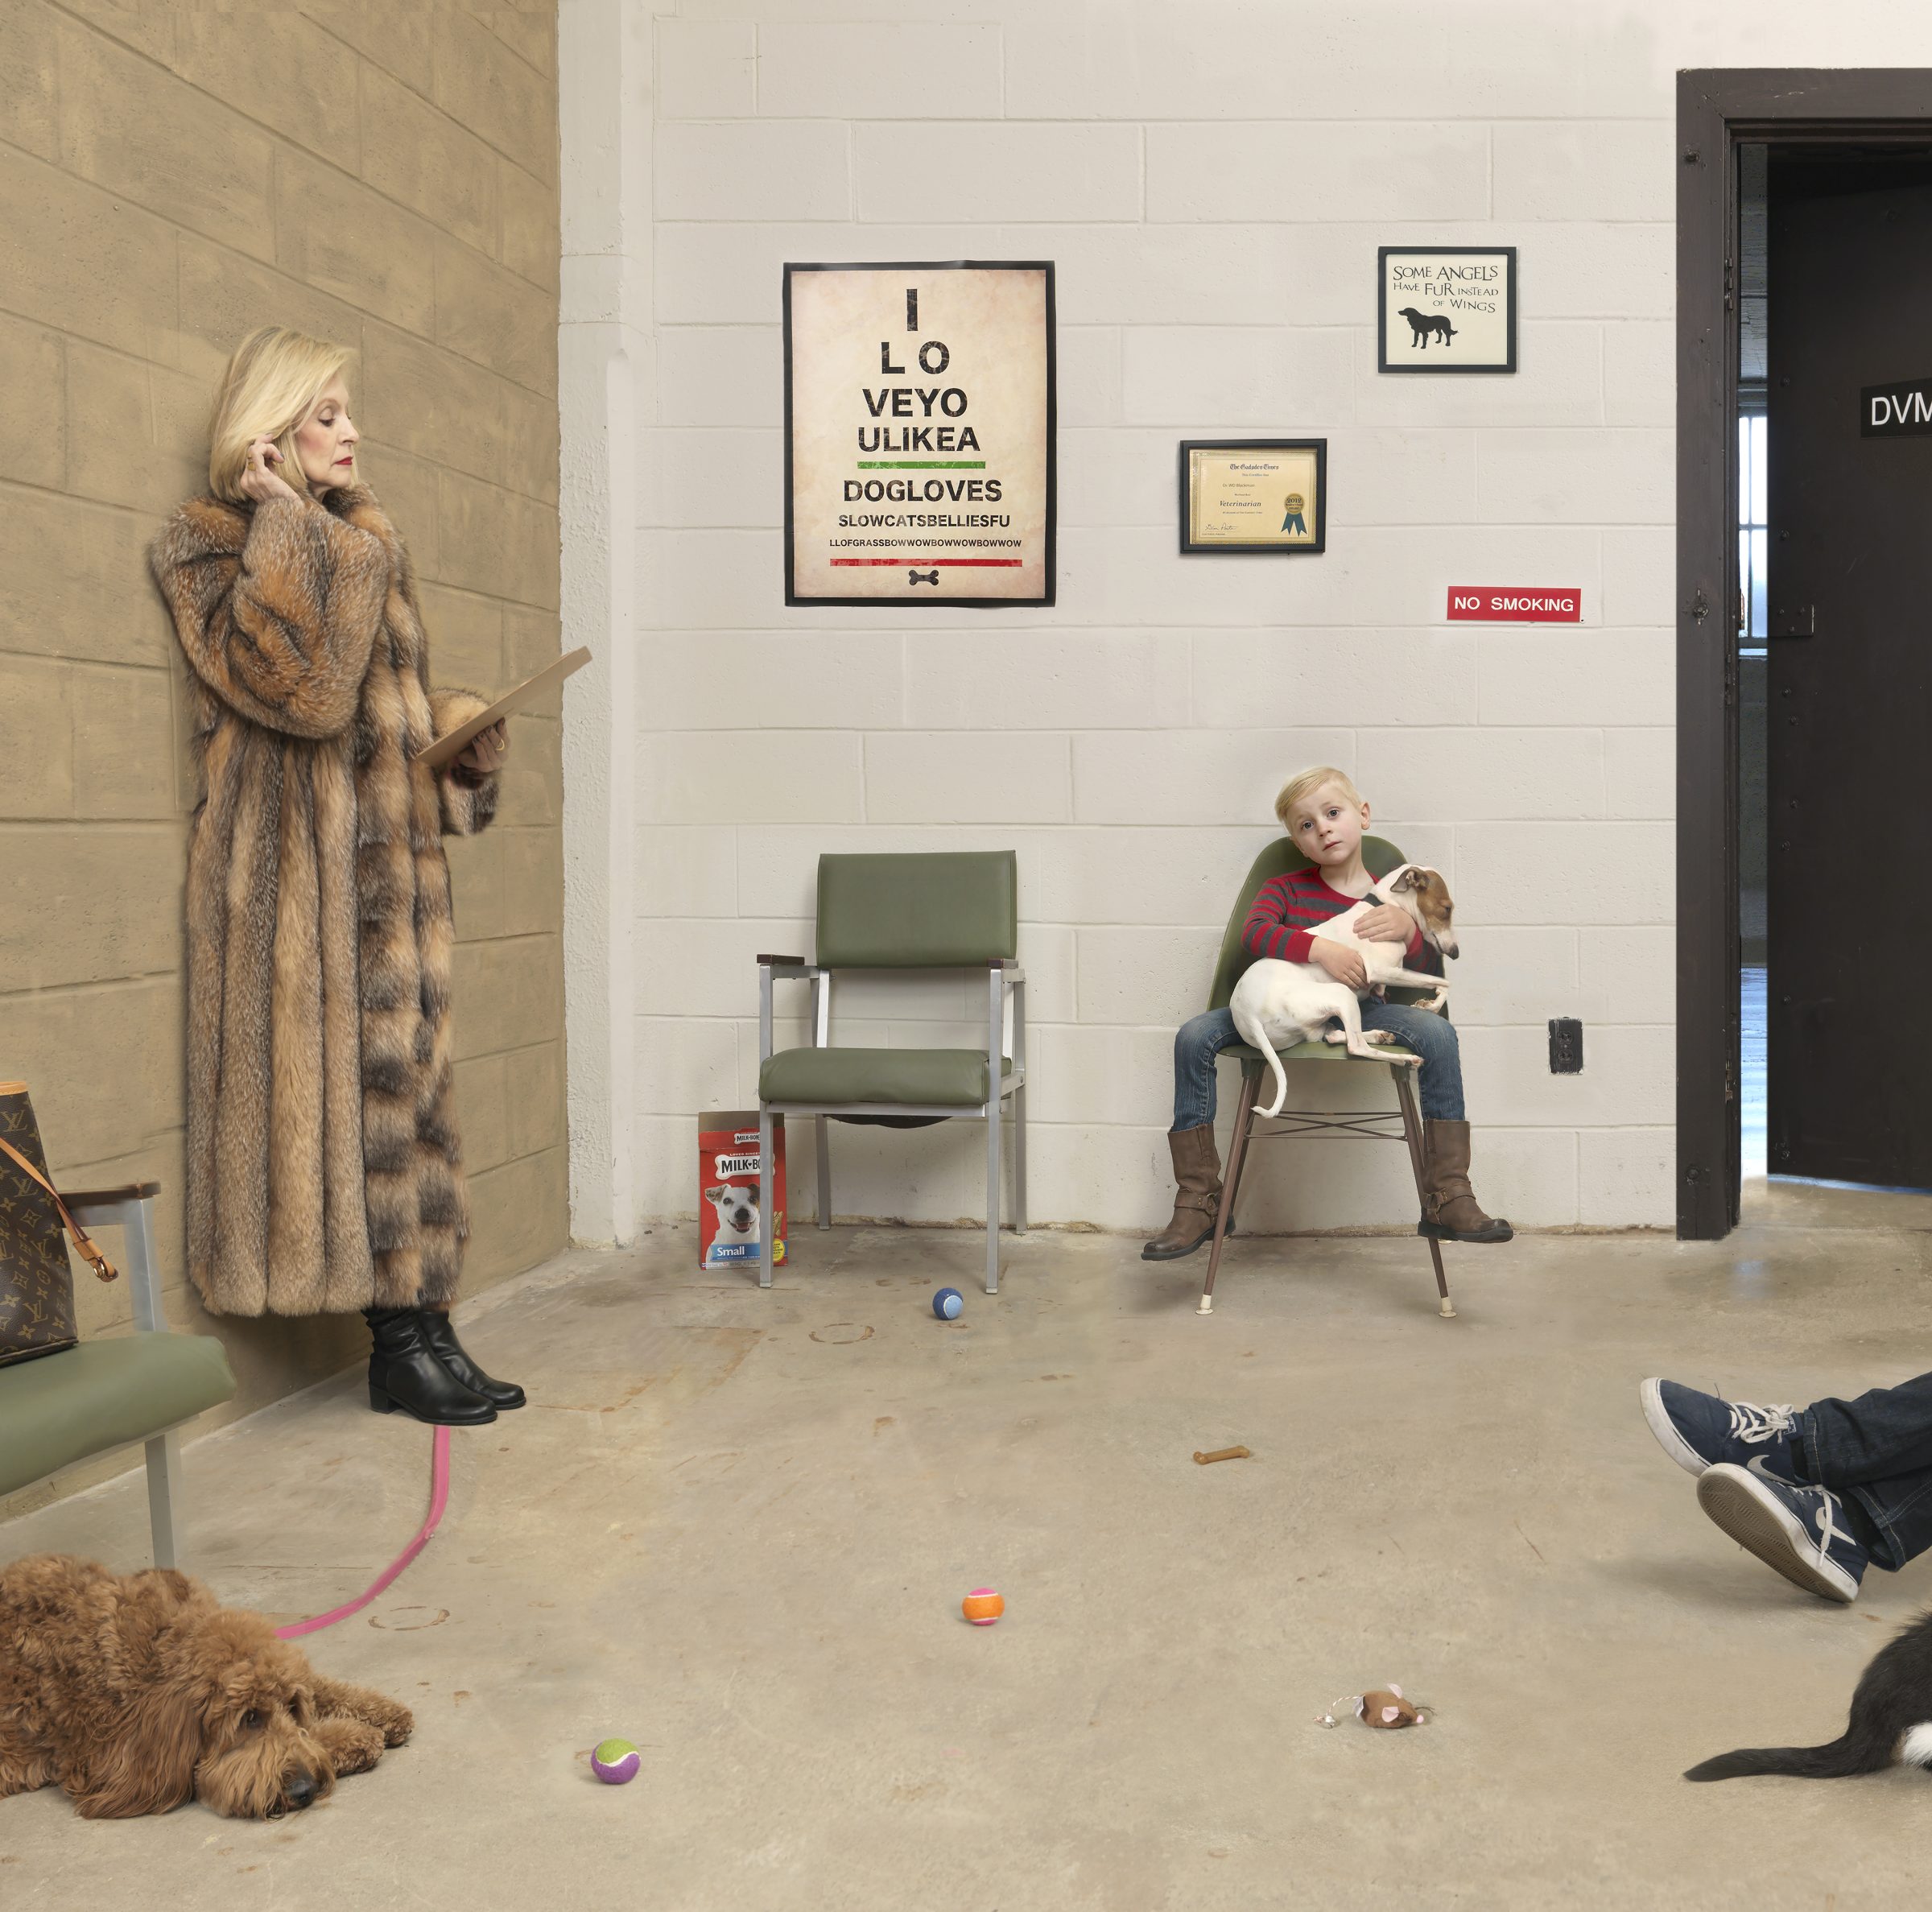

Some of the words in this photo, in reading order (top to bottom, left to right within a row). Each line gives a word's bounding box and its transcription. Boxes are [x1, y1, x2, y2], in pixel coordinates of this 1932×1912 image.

[1393, 266, 1432, 281] SOME
[1436, 266, 1498, 281] ANGELS
[1393, 282, 1420, 291] HAVE
[1425, 283, 1455, 296] FUR
[1458, 287, 1499, 296] INSTEAD
[906, 288, 919, 332] I
[1450, 299, 1496, 313] WINGS
[862, 387, 968, 418] VEYO
[1872, 392, 1932, 425] DVM
[858, 426, 980, 452] ULIKEA
[844, 479, 1002, 502] DOGLOVES
[838, 514, 1010, 528] SLOWCATSBELLIESFU
[829, 539, 1022, 548] LLOFGRASSBOWWOWBOWWOWBOWWOW
[1455, 597, 1480, 610] NO
[1491, 597, 1574, 612] SMOKING
[717, 1246, 745, 1256] Small
